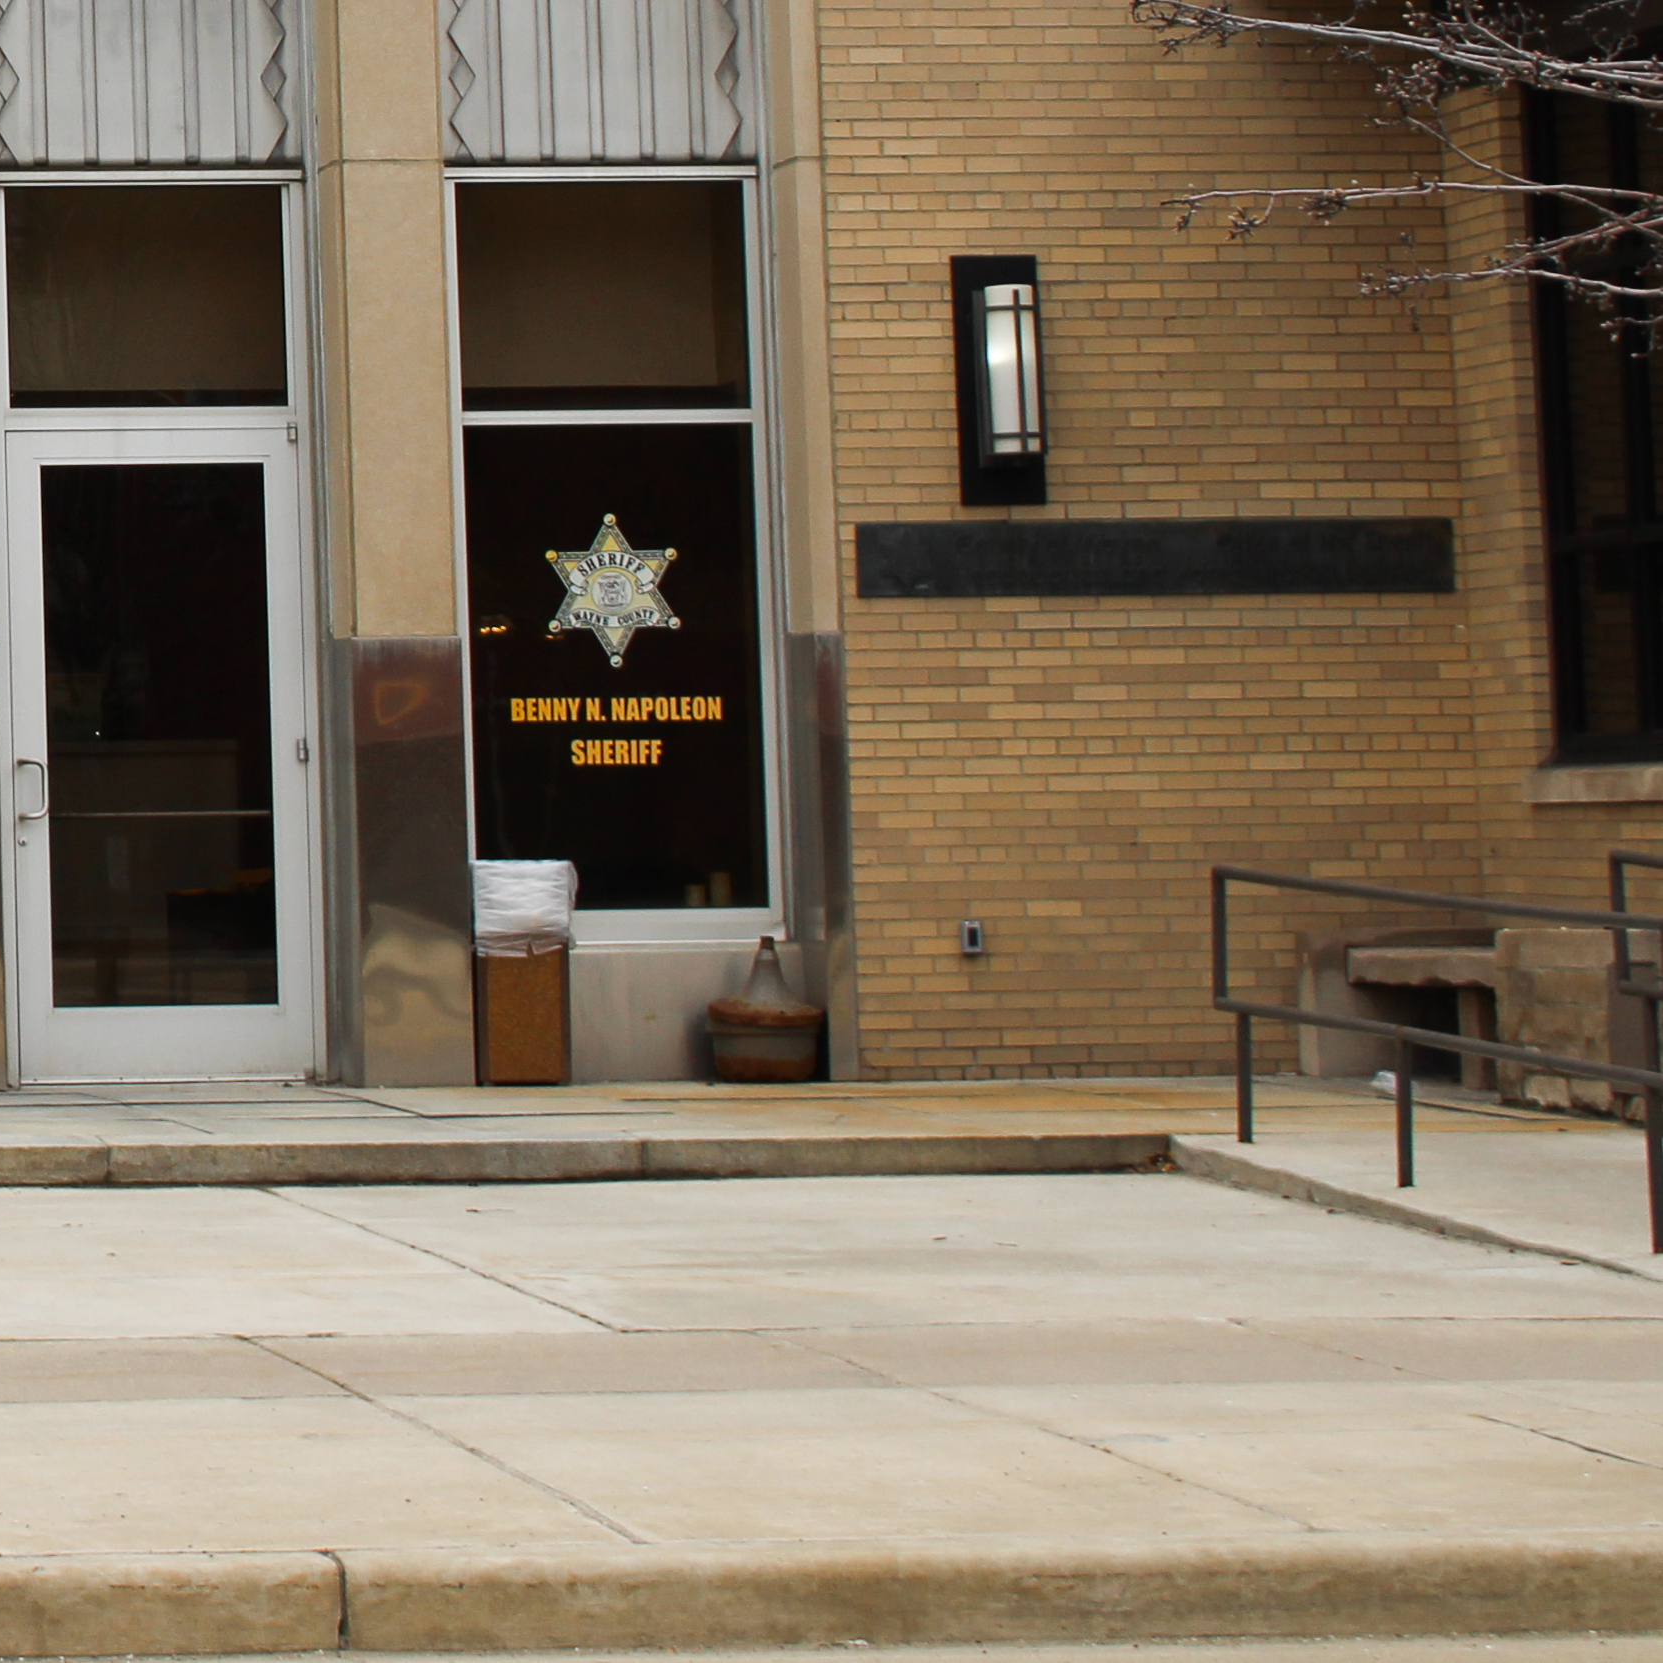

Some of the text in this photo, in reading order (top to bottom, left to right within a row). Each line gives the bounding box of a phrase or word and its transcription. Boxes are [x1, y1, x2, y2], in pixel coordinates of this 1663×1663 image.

[578, 551, 645, 577] SHERIFF
[572, 610, 655, 626] WAYNE COUNTY
[510, 696, 723, 722] BENNY N. NAPOLEON
[570, 739, 663, 765] SHERIFF
